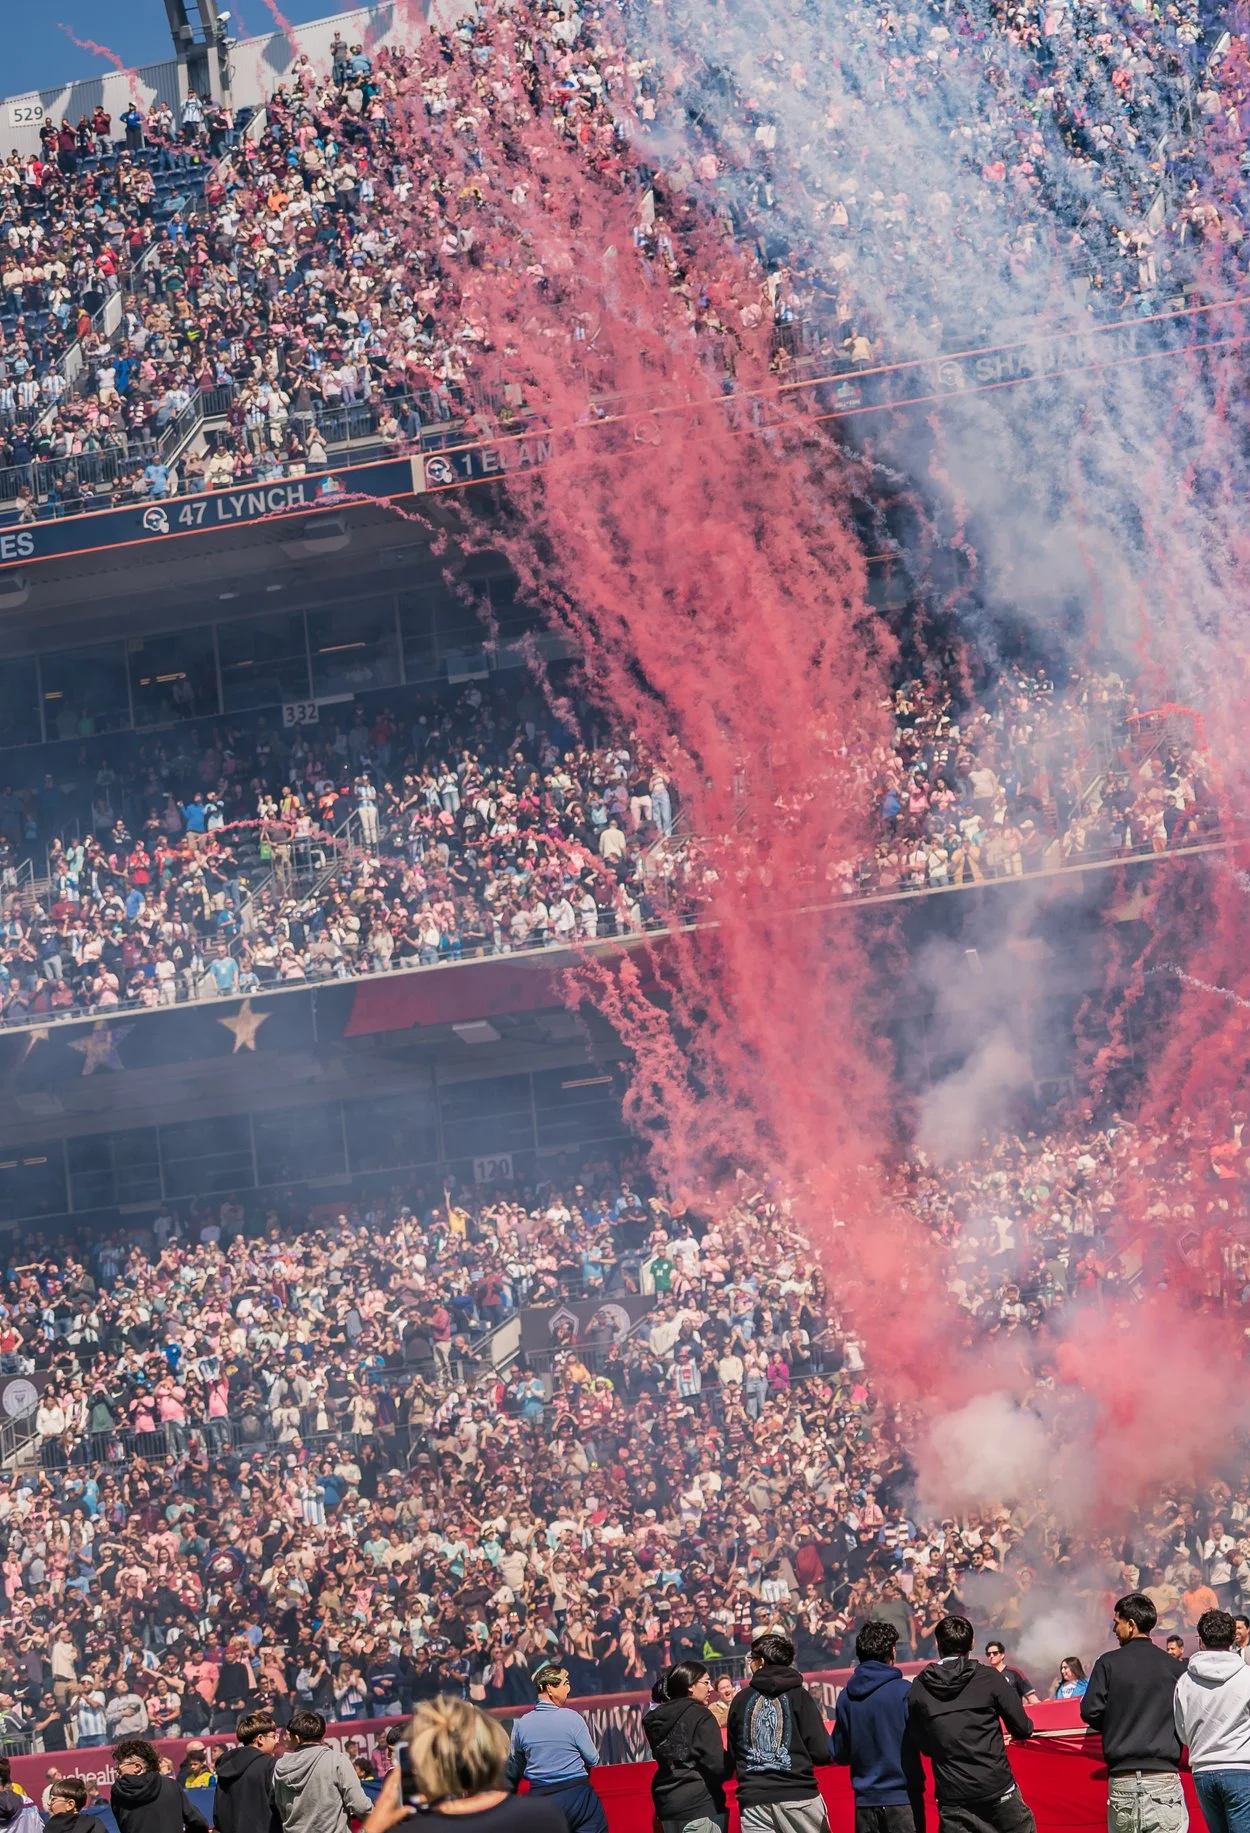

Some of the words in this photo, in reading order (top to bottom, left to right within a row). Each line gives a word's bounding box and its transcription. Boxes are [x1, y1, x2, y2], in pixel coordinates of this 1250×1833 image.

[14, 106, 43, 122] 529
[179, 502, 208, 526] 47
[217, 484, 305, 521] LYNCH
[286, 704, 317, 722] 332
[477, 1159, 510, 1179] 120
